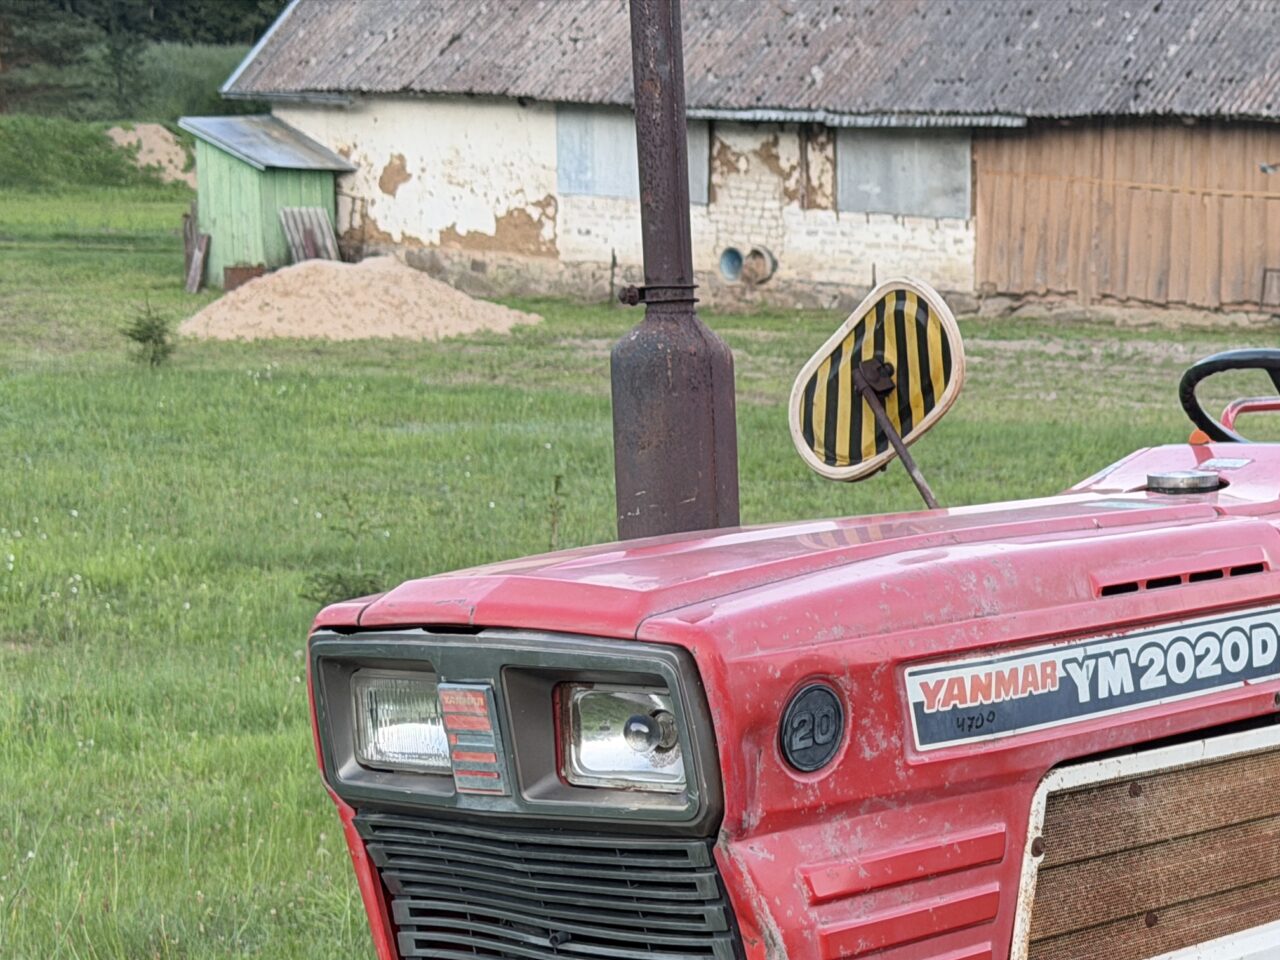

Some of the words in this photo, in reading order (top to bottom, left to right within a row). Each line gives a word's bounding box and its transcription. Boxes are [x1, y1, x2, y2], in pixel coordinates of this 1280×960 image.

[919, 658, 1059, 712] YANMAR
[1065, 624, 1279, 704] YM2020D
[791, 706, 836, 752] 20
[956, 710, 996, 733] 4700
